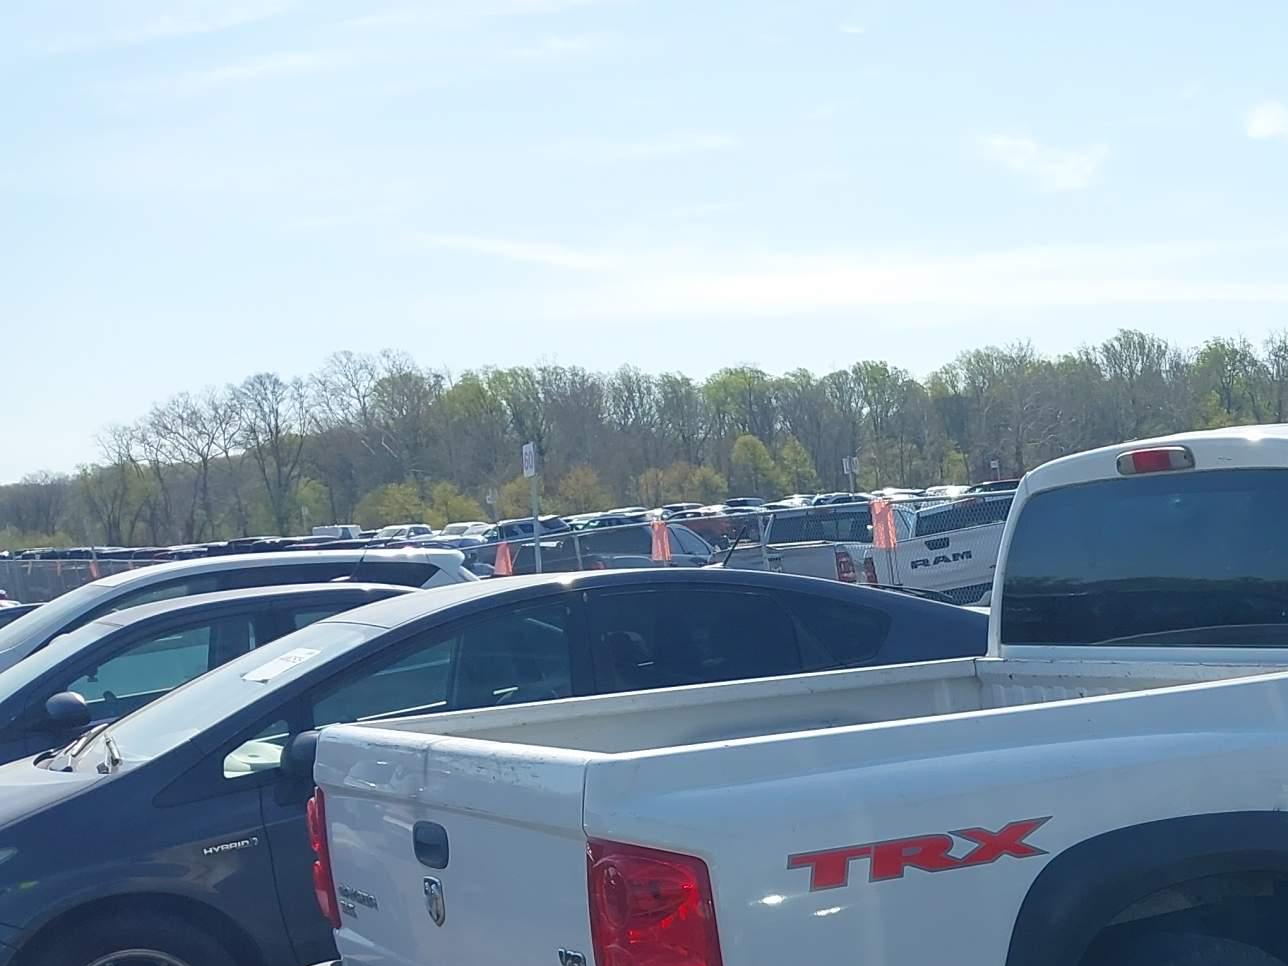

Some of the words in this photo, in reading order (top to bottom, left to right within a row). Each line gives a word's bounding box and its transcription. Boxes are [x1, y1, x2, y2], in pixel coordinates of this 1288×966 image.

[910, 550, 973, 570] RAM
[202, 839, 250, 856] HYBRID
[786, 815, 1053, 893] TRX
